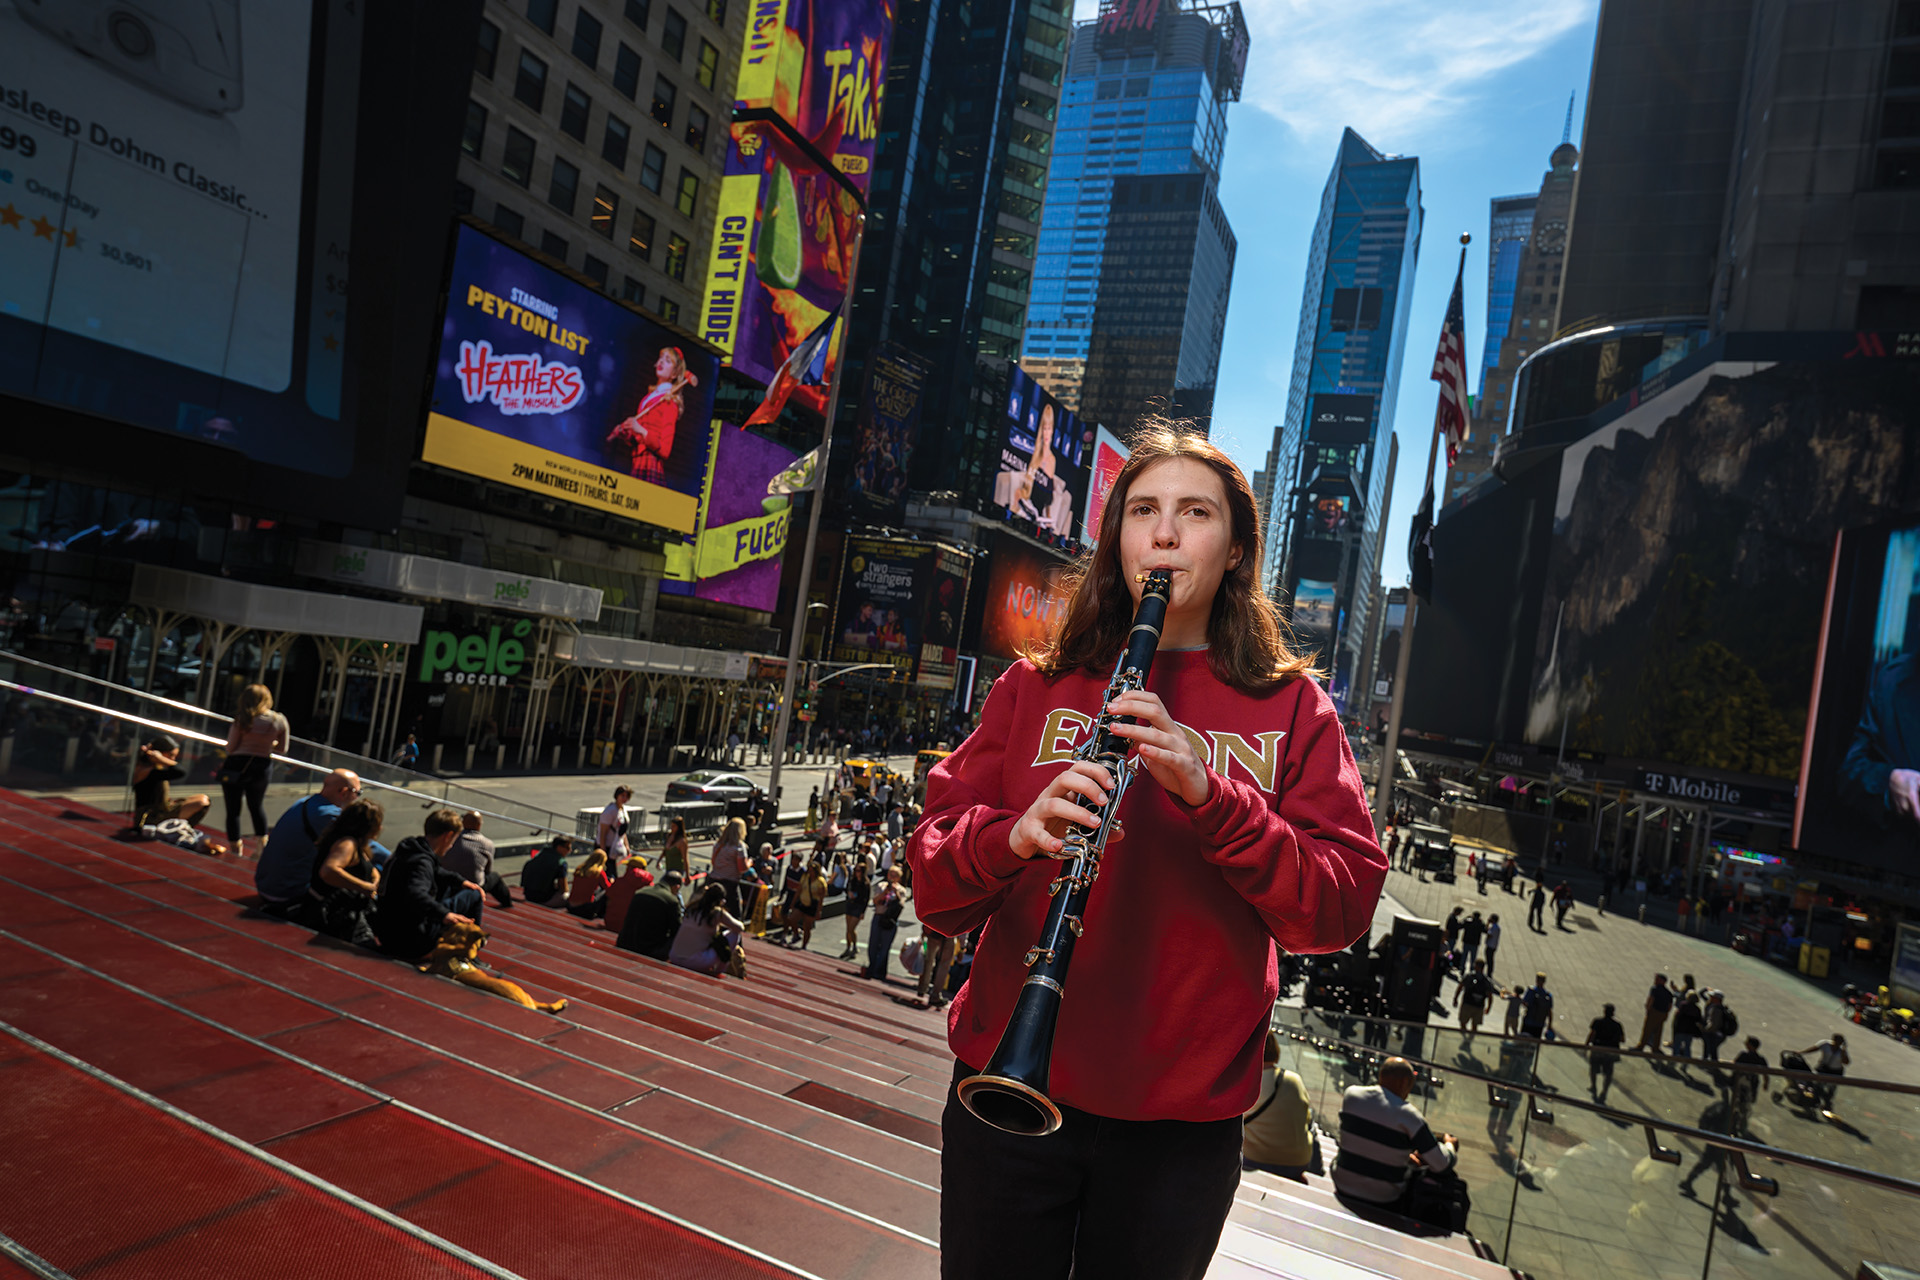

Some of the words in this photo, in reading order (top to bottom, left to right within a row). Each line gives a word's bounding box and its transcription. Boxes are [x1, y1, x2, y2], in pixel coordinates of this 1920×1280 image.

[90, 122, 165, 173] Dohm
[173, 162, 268, 220] Classic...
[25, 177, 100, 220] One-Day
[100, 242, 152, 272] 30,901
[715, 216, 747, 281] CAN'T
[467, 284, 549, 339] PEYTON
[549, 323, 590, 356] LIST
[511, 286, 559, 322] STARRING
[705, 290, 736, 343] HIDE
[460, 342, 582, 405] HEATHERS
[873, 374, 889, 396] THE
[503, 397, 521, 410] THE
[522, 396, 562, 410] MUSICAL
[512, 463, 534, 480] 2PM
[535, 467, 580, 495] MATINEES
[626, 493, 640, 511] SUN
[333, 549, 368, 574] pelé
[869, 560, 889, 574] two
[494, 578, 532, 600] pelé
[862, 571, 912, 589] strangers
[1005, 580, 1054, 622] NOW
[419, 618, 532, 683] pelé
[857, 650, 869, 662] OF
[890, 655, 914, 668] YEAR
[443, 671, 508, 687] SOCCER
[1031, 708, 1287, 794] EN
[1494, 751, 1523, 767] SEPHORA
[1667, 776, 1740, 804] Mobile
